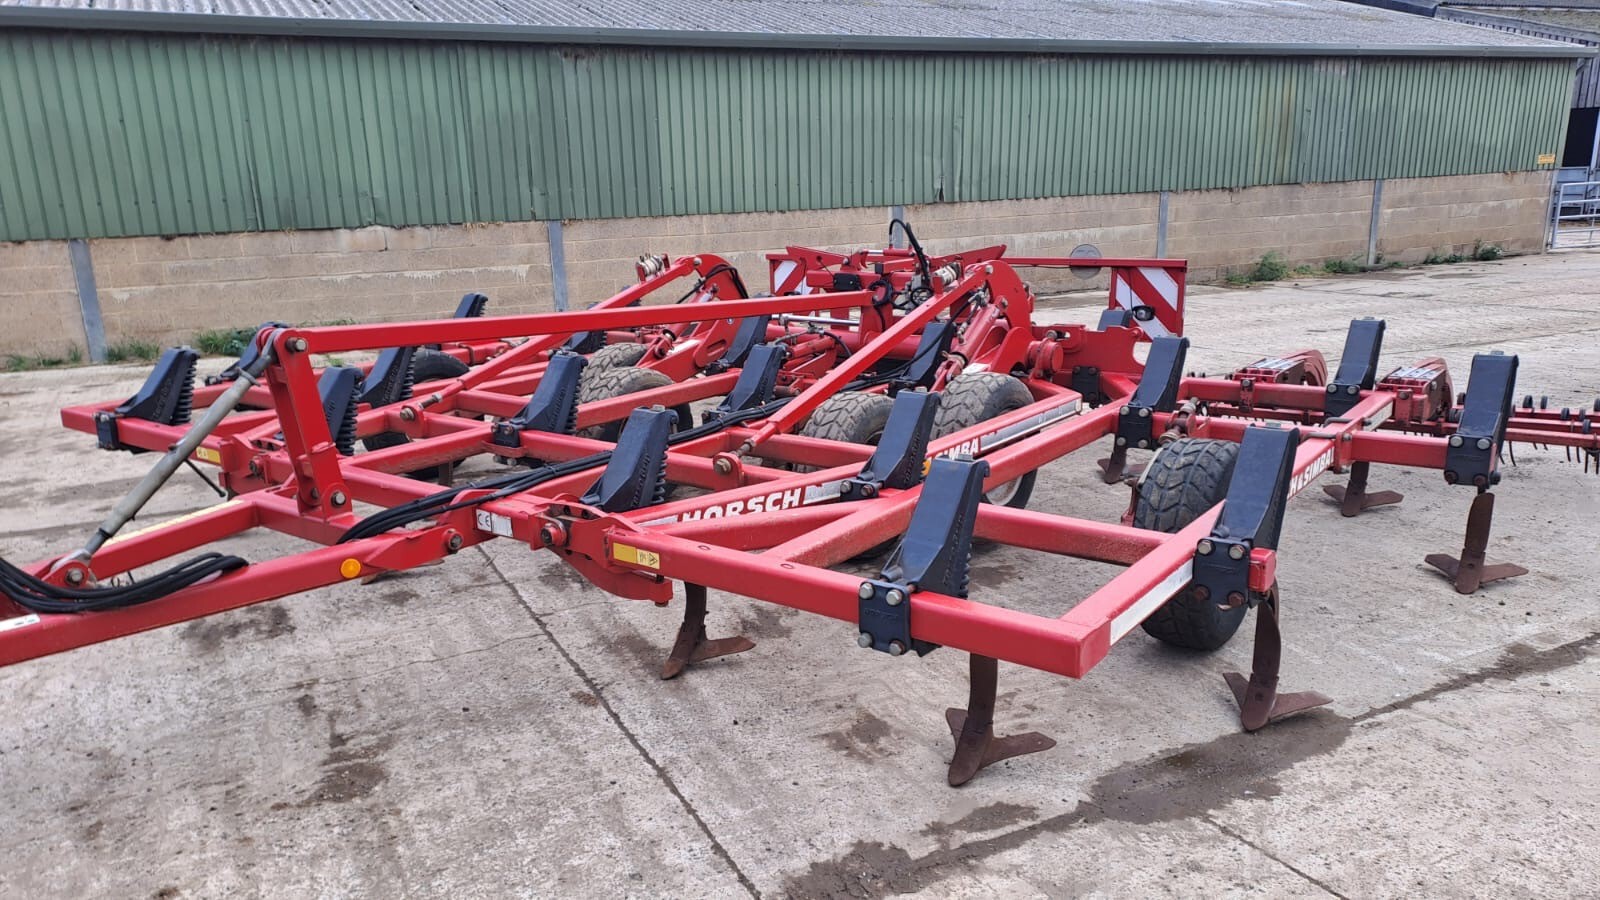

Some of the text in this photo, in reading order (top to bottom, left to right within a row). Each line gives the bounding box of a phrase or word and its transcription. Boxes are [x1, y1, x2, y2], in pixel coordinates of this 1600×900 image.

[935, 437, 979, 460] MBA
[1304, 448, 1331, 486] SIMBA
[682, 488, 801, 523] HORSCH
